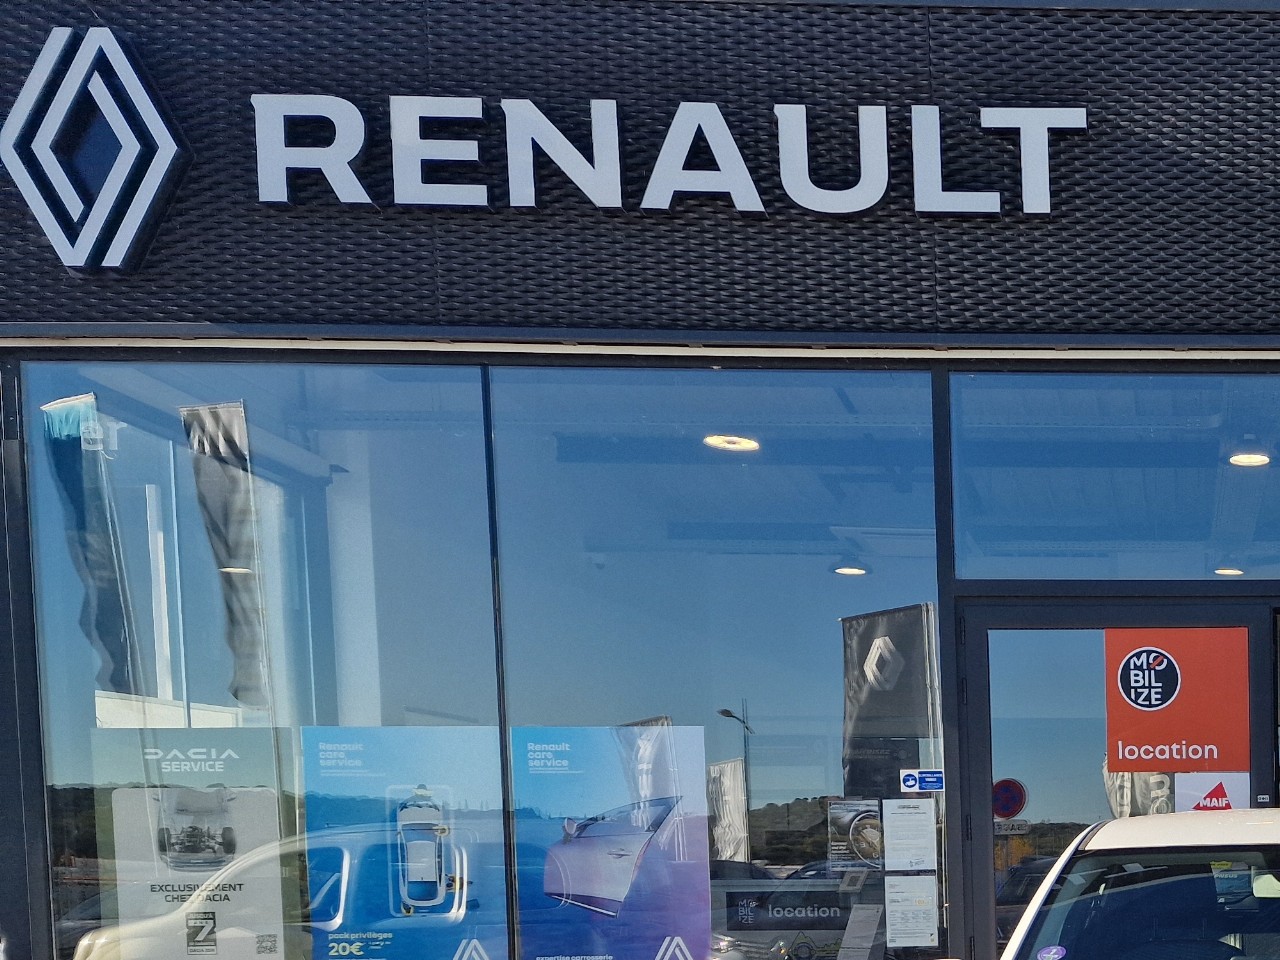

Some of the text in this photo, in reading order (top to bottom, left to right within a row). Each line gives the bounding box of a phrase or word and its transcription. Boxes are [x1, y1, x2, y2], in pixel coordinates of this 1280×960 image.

[250, 93, 1088, 214] RENAULT
[1130, 652, 1167, 670] MO
[1130, 670, 1163, 687] BIL
[1130, 688, 1163, 705] IZE
[319, 742, 364, 751] Renault
[527, 742, 571, 751] Renault
[1118, 740, 1218, 760] location
[143, 749, 240, 759] DACIA
[319, 751, 346, 759] care
[527, 751, 553, 759] care
[161, 761, 224, 772] SERVICE
[319, 759, 362, 767] service
[528, 759, 569, 767] service
[1200, 797, 1230, 808] MAIF
[767, 904, 840, 918] location
[328, 932, 350, 940] pack
[328, 942, 366, 956] 20€
